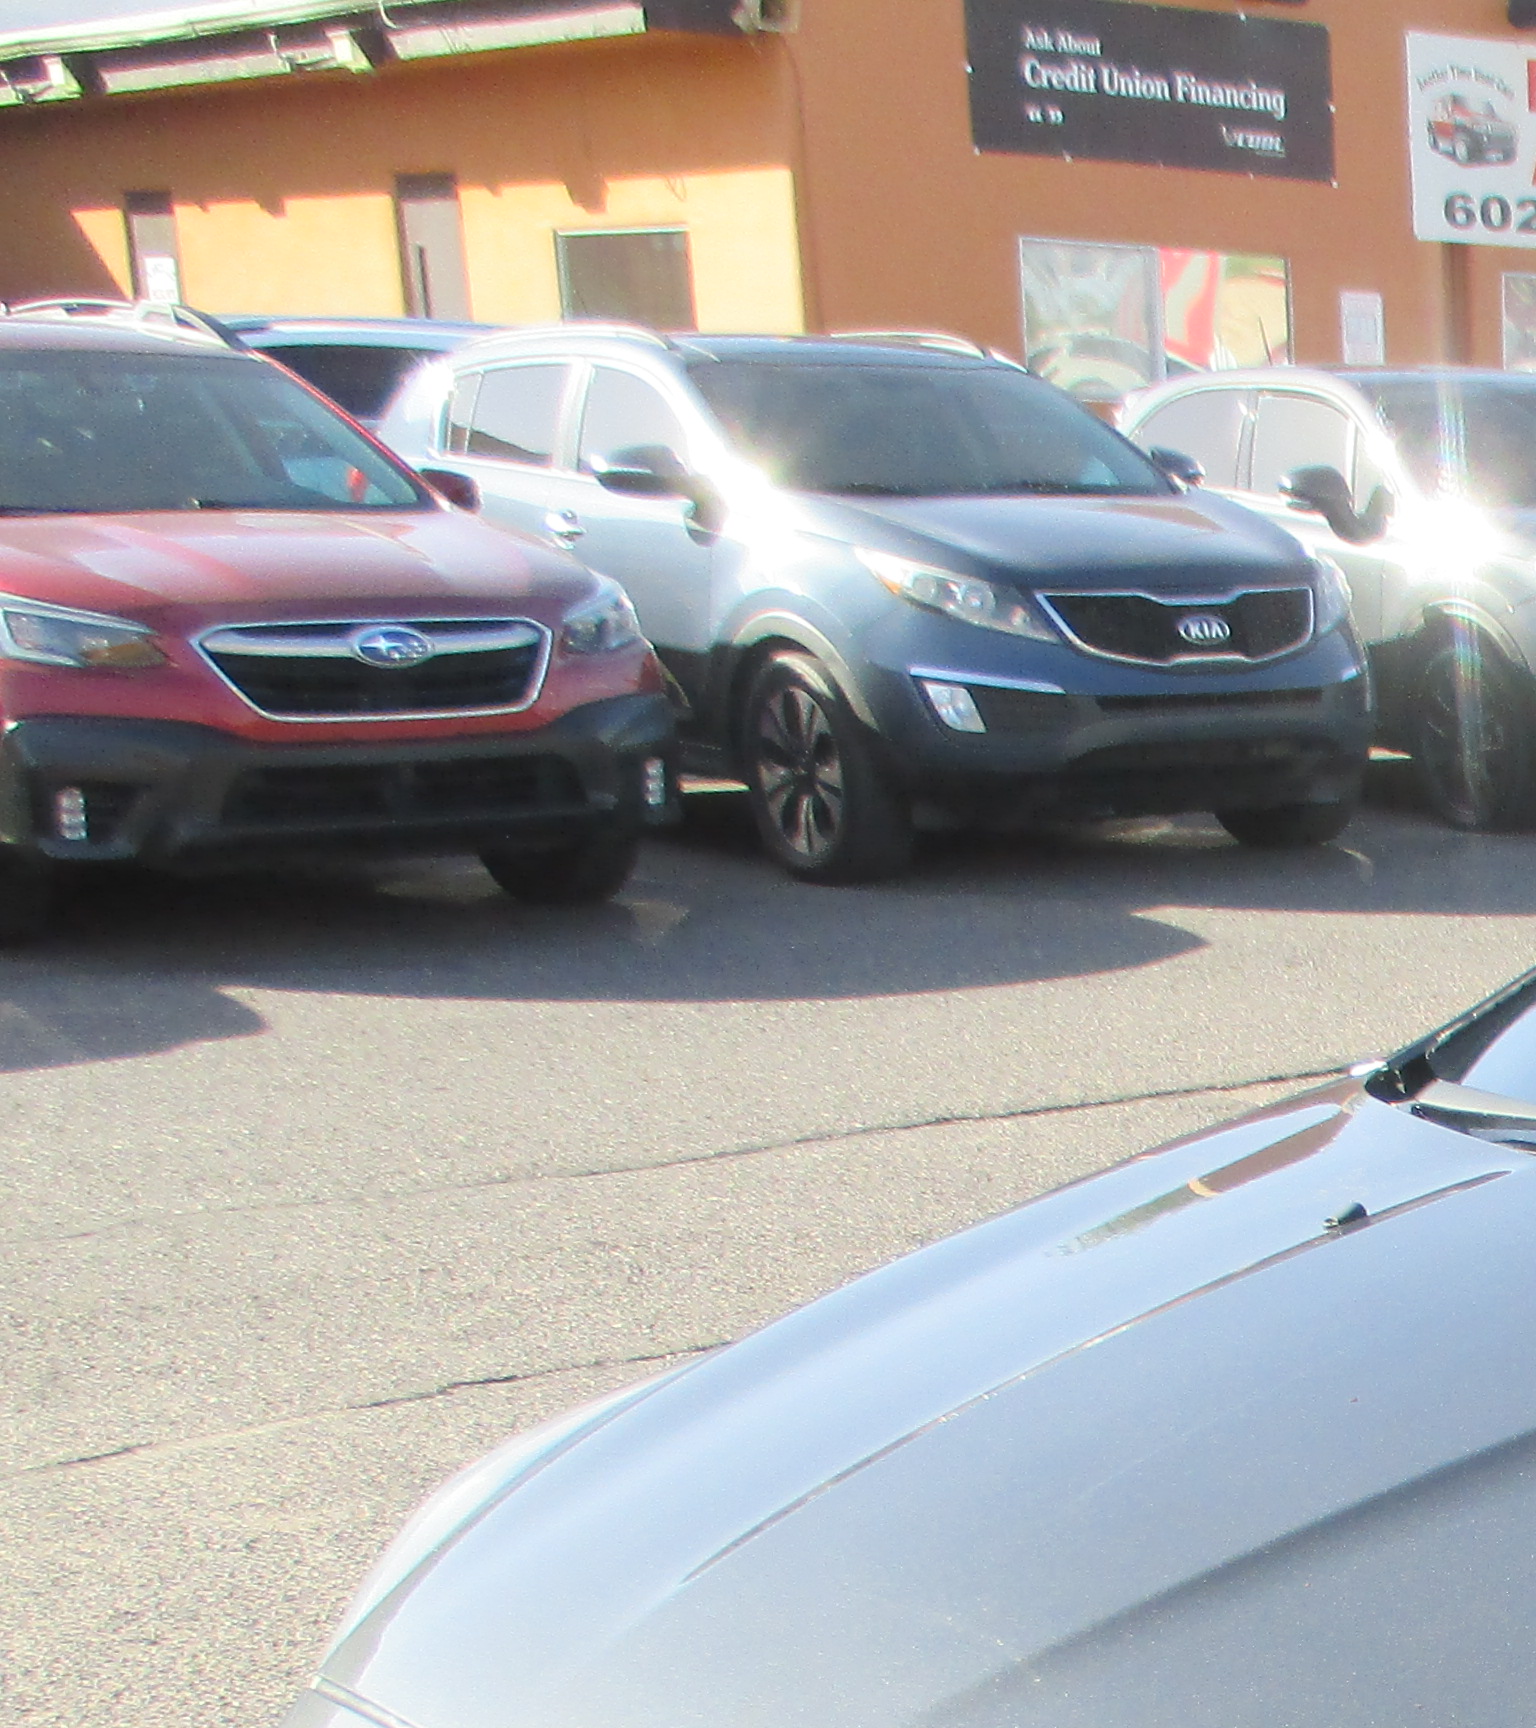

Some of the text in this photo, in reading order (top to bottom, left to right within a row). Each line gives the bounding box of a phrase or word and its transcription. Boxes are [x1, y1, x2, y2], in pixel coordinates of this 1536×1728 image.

[1022, 57, 1288, 121] Credit Union Financing
[1187, 619, 1226, 640] KIA
